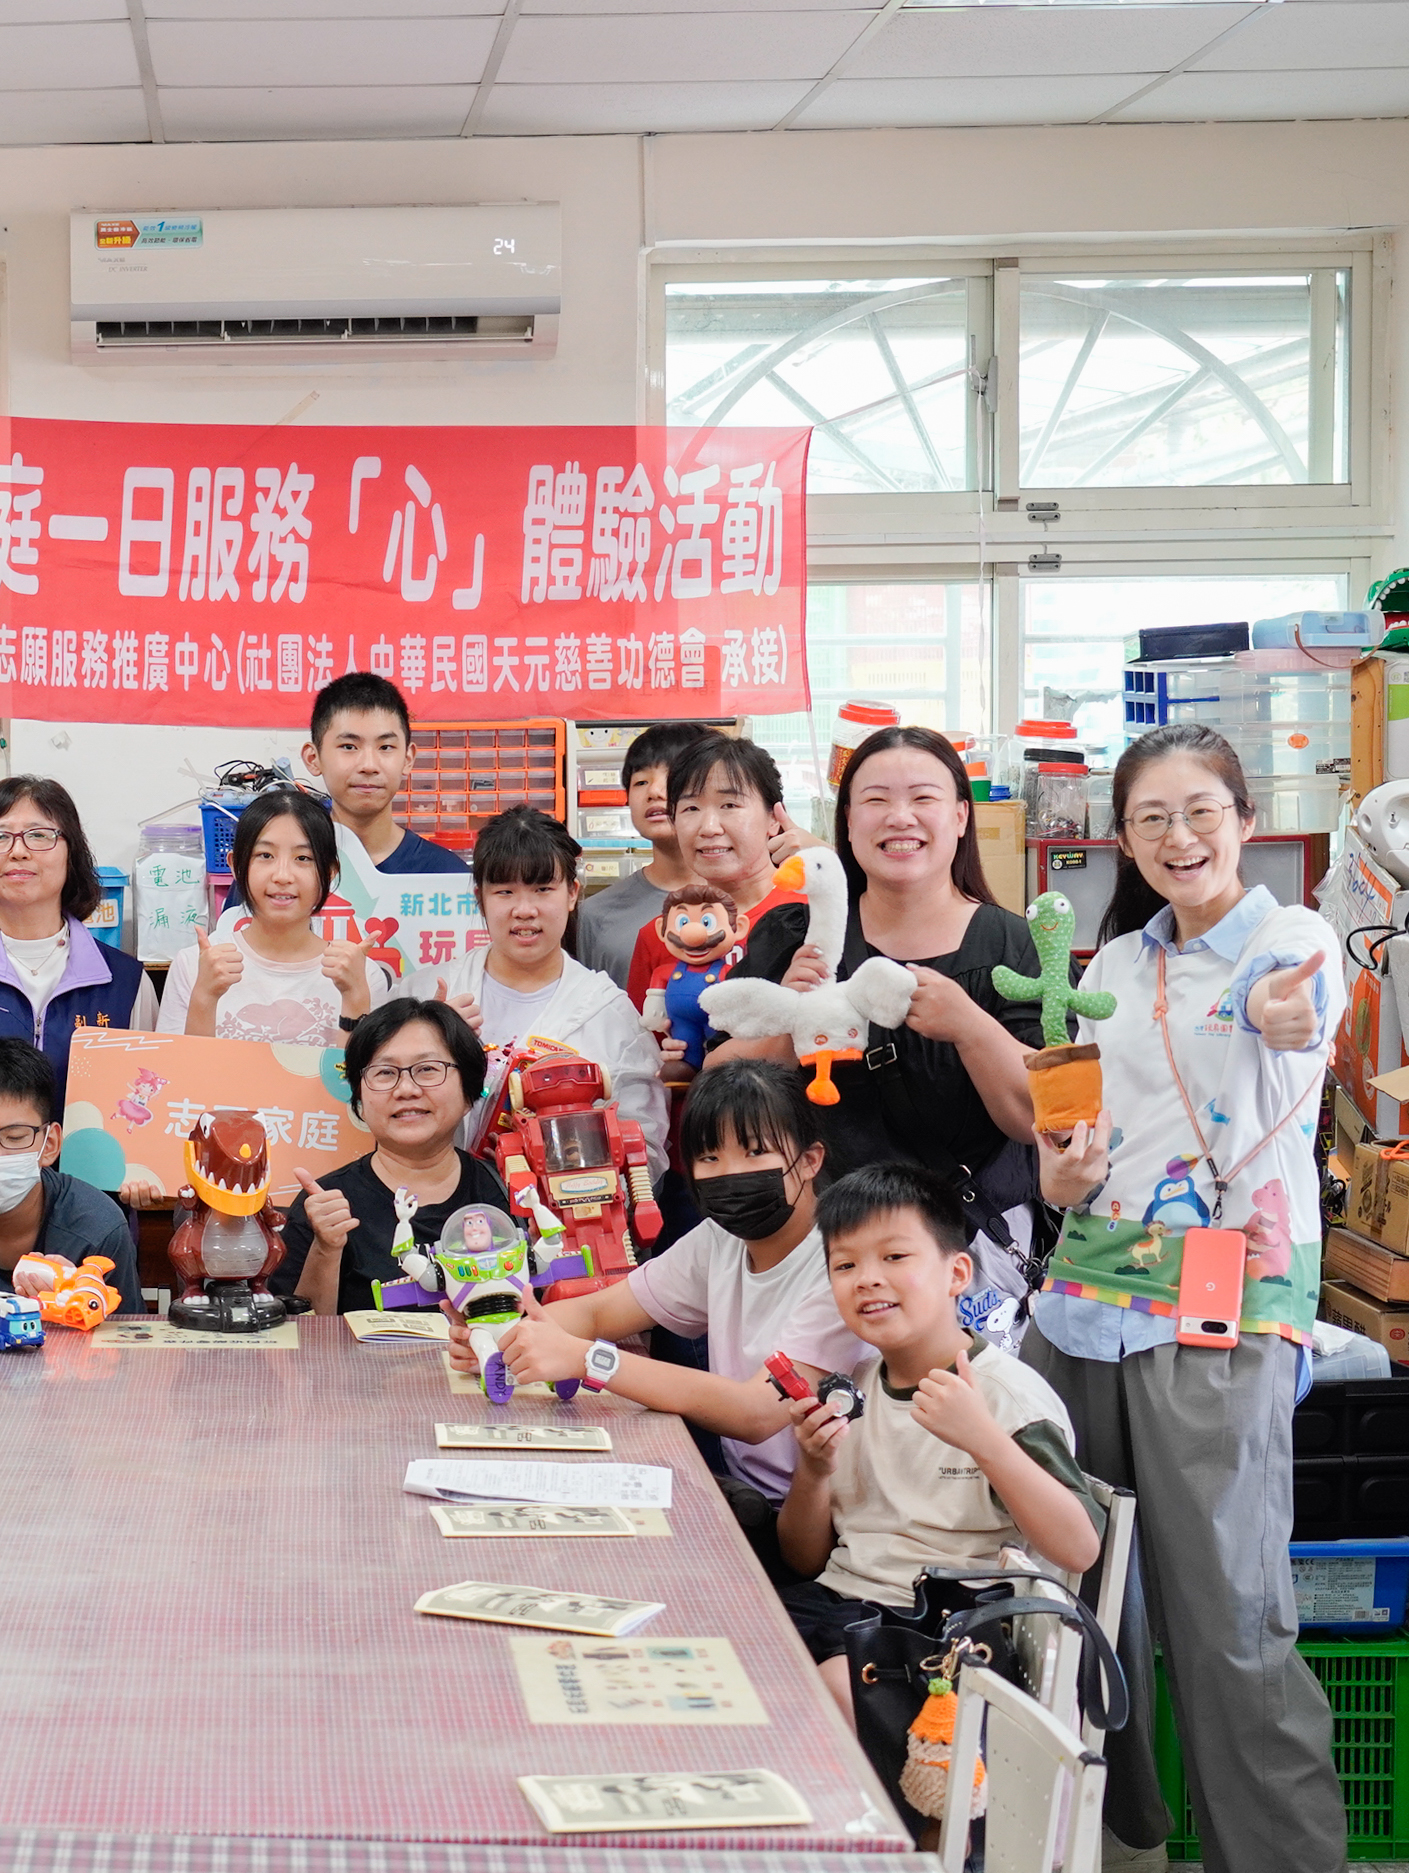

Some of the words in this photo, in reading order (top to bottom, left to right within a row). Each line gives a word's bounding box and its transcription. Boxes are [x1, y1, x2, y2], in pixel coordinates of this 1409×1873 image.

[493, 238, 516, 255] 24
[149, 864, 200, 887] 電池
[82, 902, 115, 924] 池
[399, 891, 481, 916] 新北市
[149, 904, 206, 929] 漏液
[164, 1098, 340, 1152] 志家庭
[494, 1361, 506, 1398] ANDY
